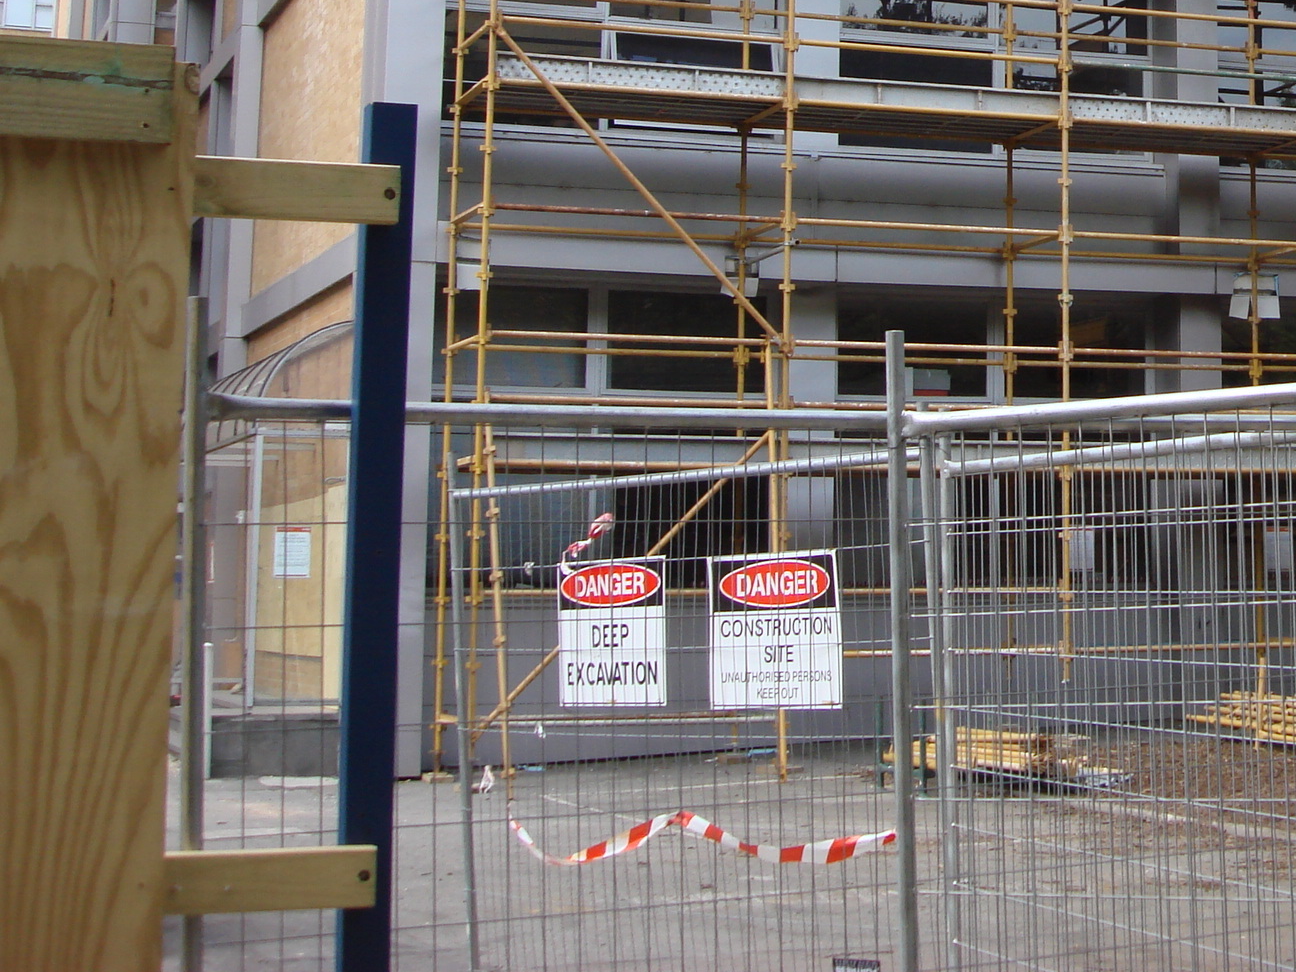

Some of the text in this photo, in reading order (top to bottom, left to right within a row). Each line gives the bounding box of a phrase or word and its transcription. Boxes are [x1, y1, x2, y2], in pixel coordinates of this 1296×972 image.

[576, 572, 645, 597] DANGER
[736, 569, 818, 597] DANGER
[592, 624, 629, 648] DEEP
[721, 616, 832, 637] CONSTRUCTION
[764, 645, 794, 663] SITE
[567, 661, 657, 687] EXCAVATION
[721, 670, 832, 683] UNAUTHORISED PERSONS
[781, 688, 799, 699] OUT
